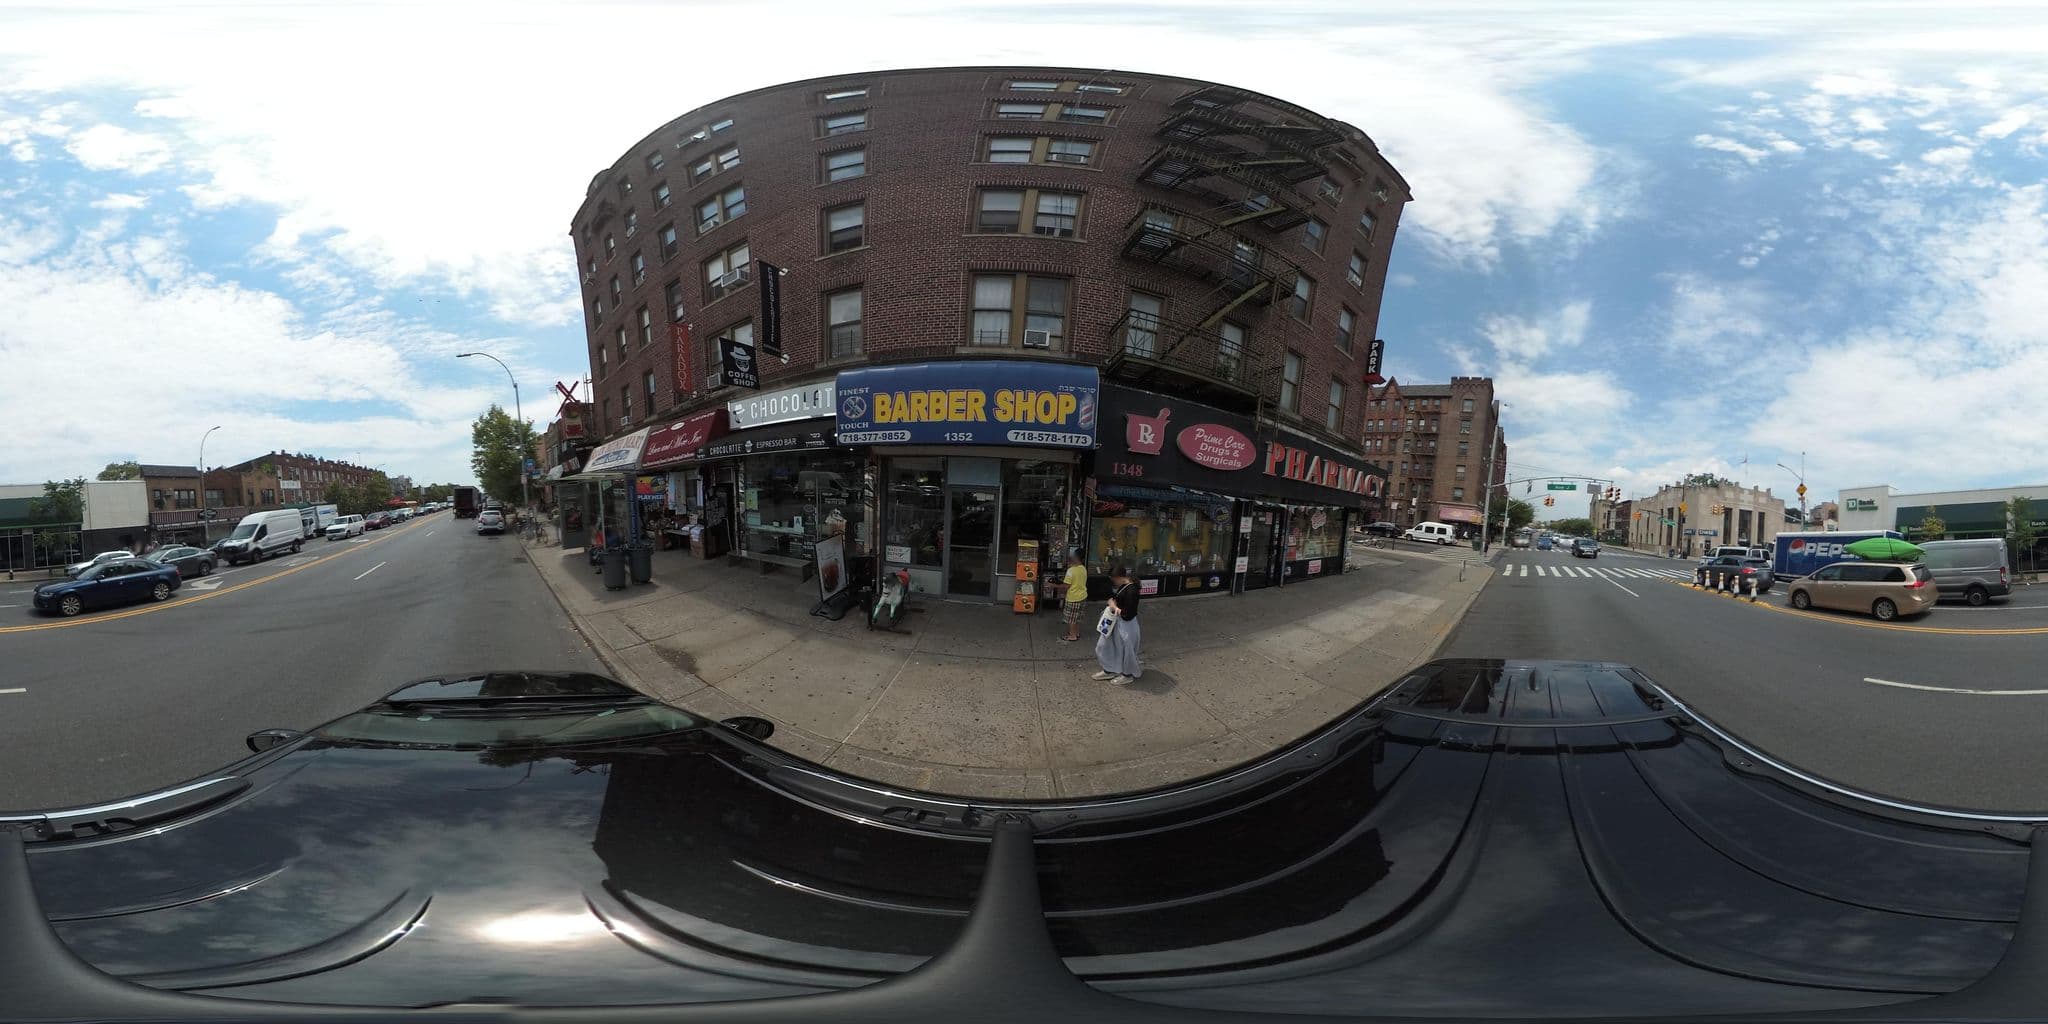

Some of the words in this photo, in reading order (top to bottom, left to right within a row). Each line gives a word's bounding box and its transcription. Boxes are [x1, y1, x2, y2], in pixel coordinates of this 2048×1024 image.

[677, 327, 687, 390] PARADOX
[1368, 342, 1379, 374] PARK
[728, 370, 757, 382] COFFEE
[733, 379, 755, 387] SHOP
[839, 387, 869, 396] FINEST
[873, 389, 987, 424] BARBER
[993, 388, 1077, 425] SHOP
[840, 422, 869, 430] TOUCH
[843, 432, 906, 442] 718-377-9852
[944, 432, 973, 441] 1352
[1013, 431, 1088, 445] 718-578-1173
[1195, 428, 1223, 446] Prime
[1225, 436, 1246, 450] Care
[709, 444, 742, 455] CHOCOLATTE
[756, 440, 782, 449] ESPRESSO
[784, 437, 797, 446] BAR
[1200, 442, 1230, 457] Drugs
[1233, 450, 1240, 458] &
[1195, 452, 1242, 468] Surgicals
[1112, 462, 1144, 477] 1348
[1262, 441, 1385, 499] PHARMACY
[1804, 542, 1848, 557] PEP
